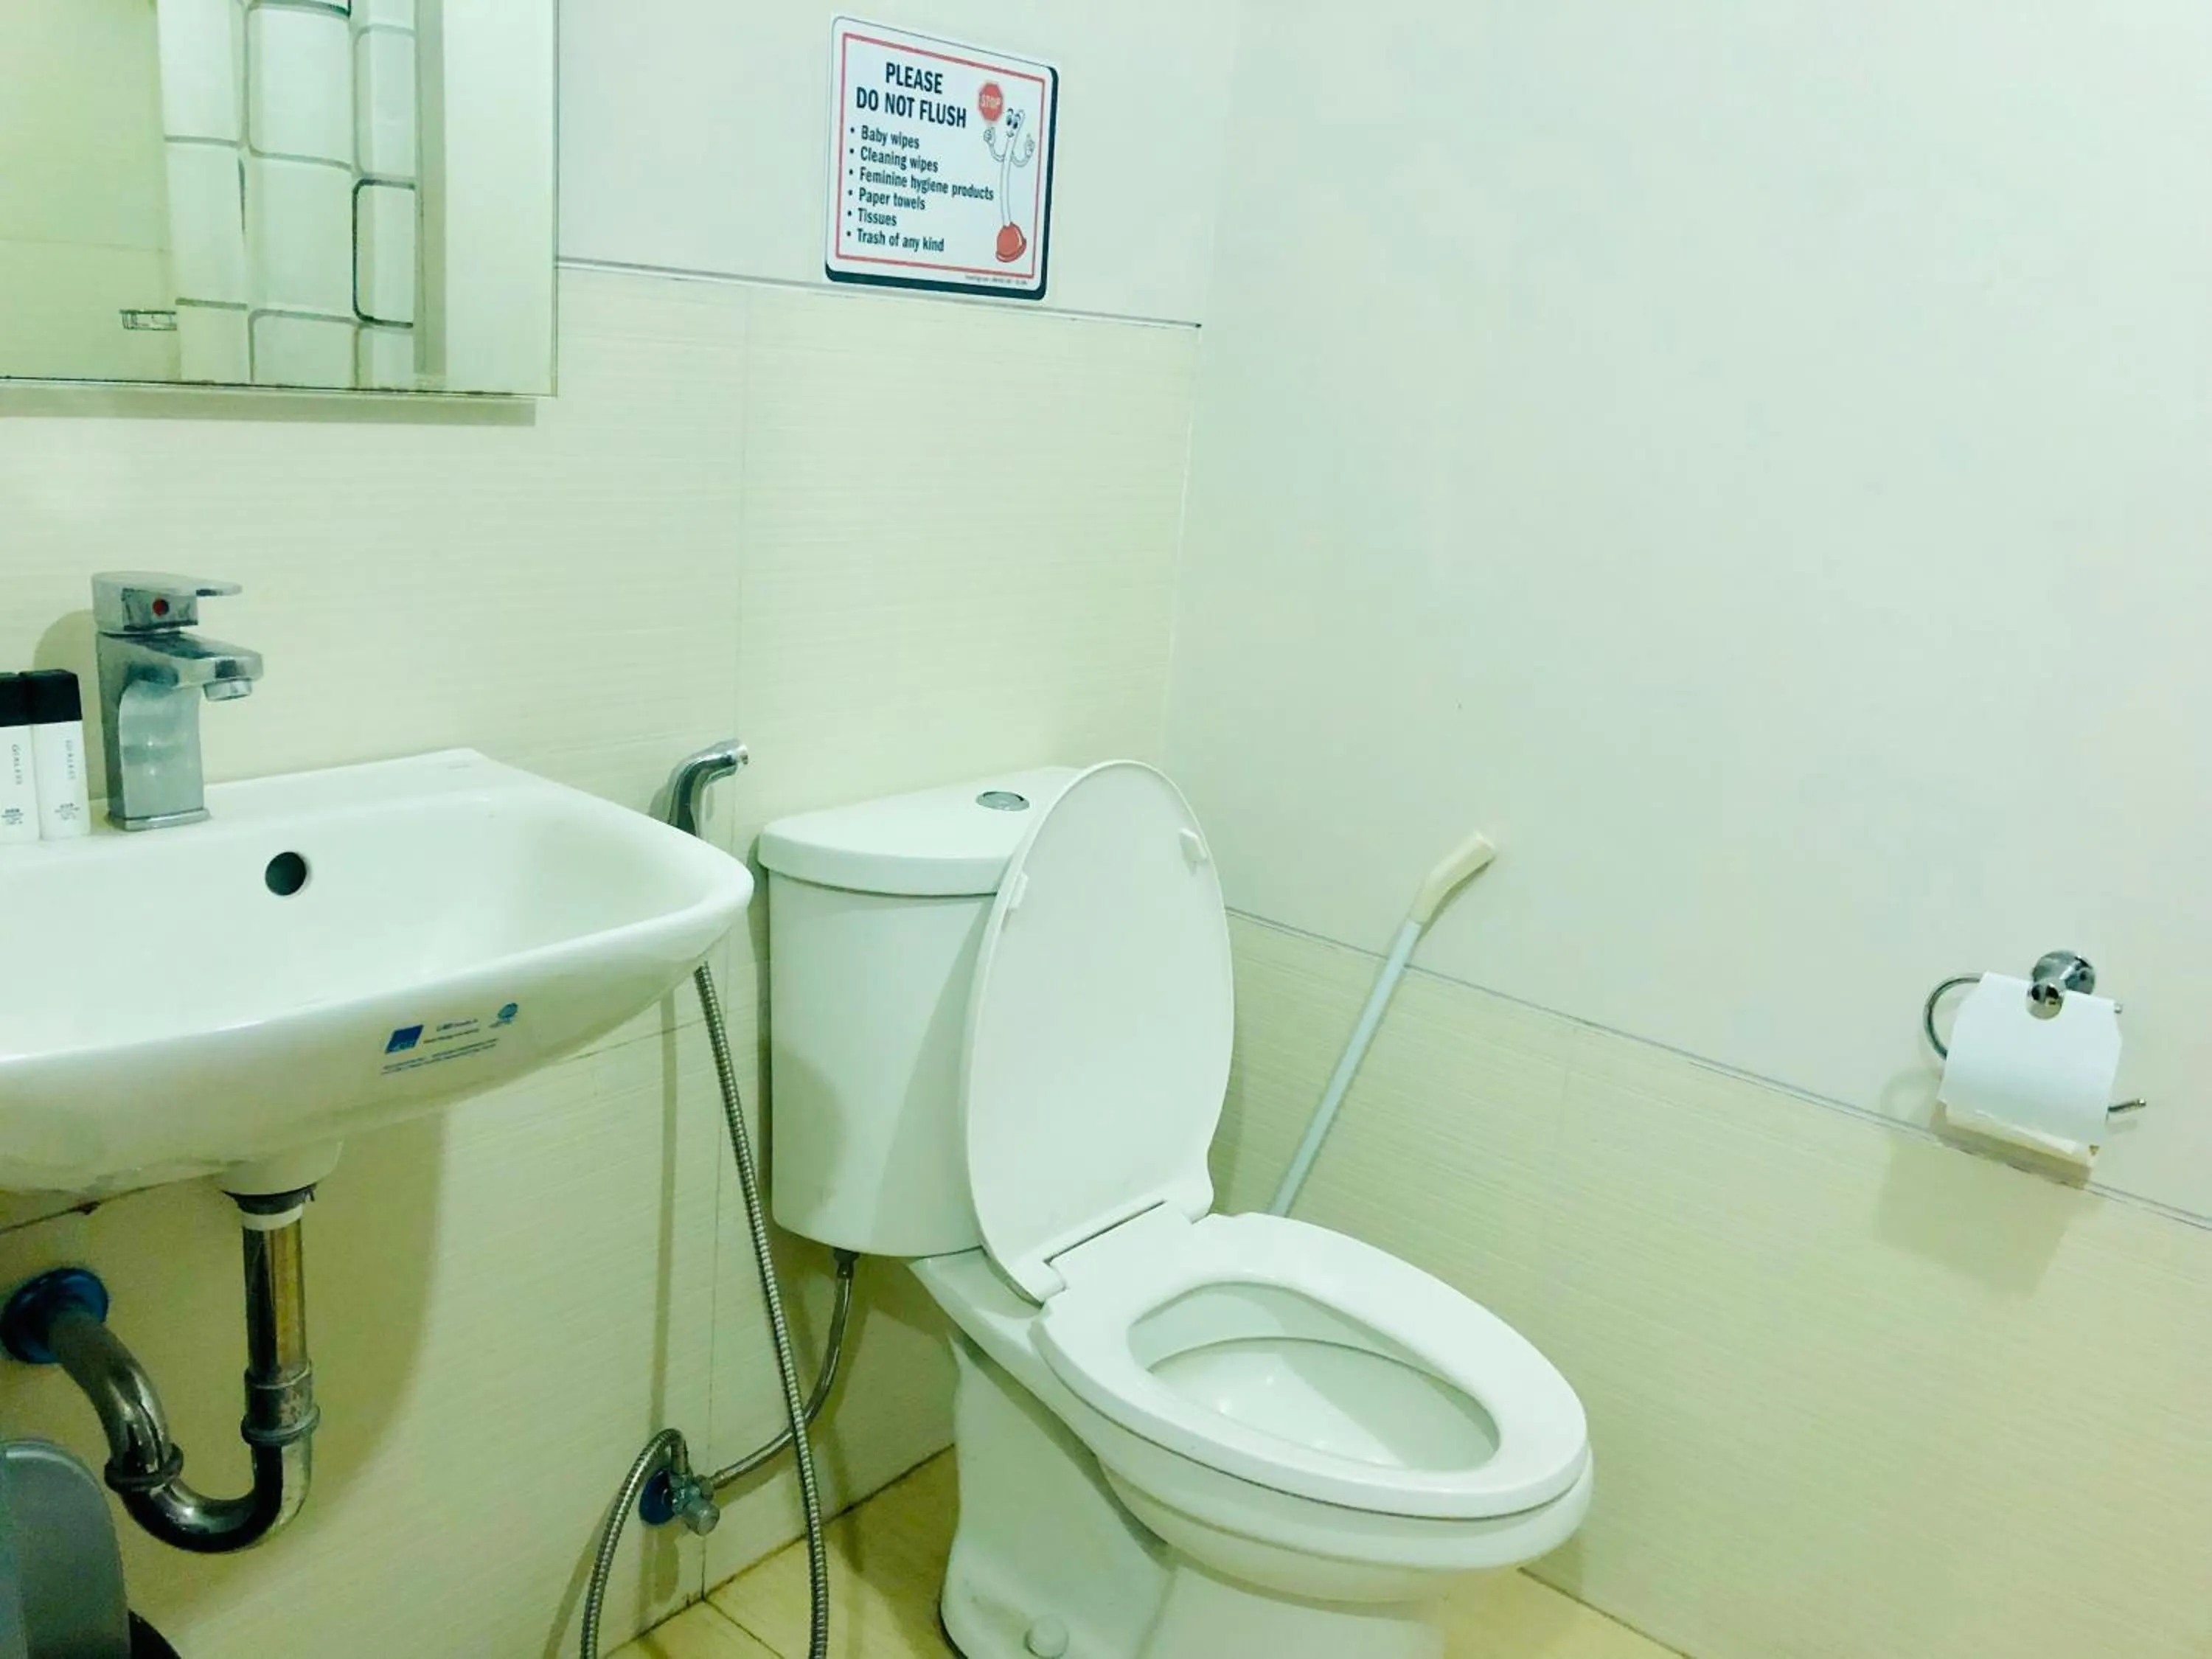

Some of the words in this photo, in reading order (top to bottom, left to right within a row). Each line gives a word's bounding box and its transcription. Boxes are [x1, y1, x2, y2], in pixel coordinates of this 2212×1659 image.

[886, 62, 944, 94] PLEASE
[856, 86, 879, 111] DO
[885, 92, 915, 118] NOT
[919, 100, 967, 128] FLUSH
[981, 94, 1001, 108] STOP
[861, 125, 888, 146] Baby
[891, 131, 920, 149] wipes
[860, 146, 907, 170] Cleaning
[910, 156, 939, 173] wipes
[860, 167, 908, 187] Feminine
[911, 174, 949, 194] hygiene
[952, 184, 995, 201] products
[859, 187, 891, 206] Paper
[893, 192, 926, 211] towels
[858, 207, 897, 226] Tissues
[857, 228, 886, 246] Trash
[889, 232, 900, 247] of
[902, 237, 920, 252] any
[923, 237, 945, 252] kind
